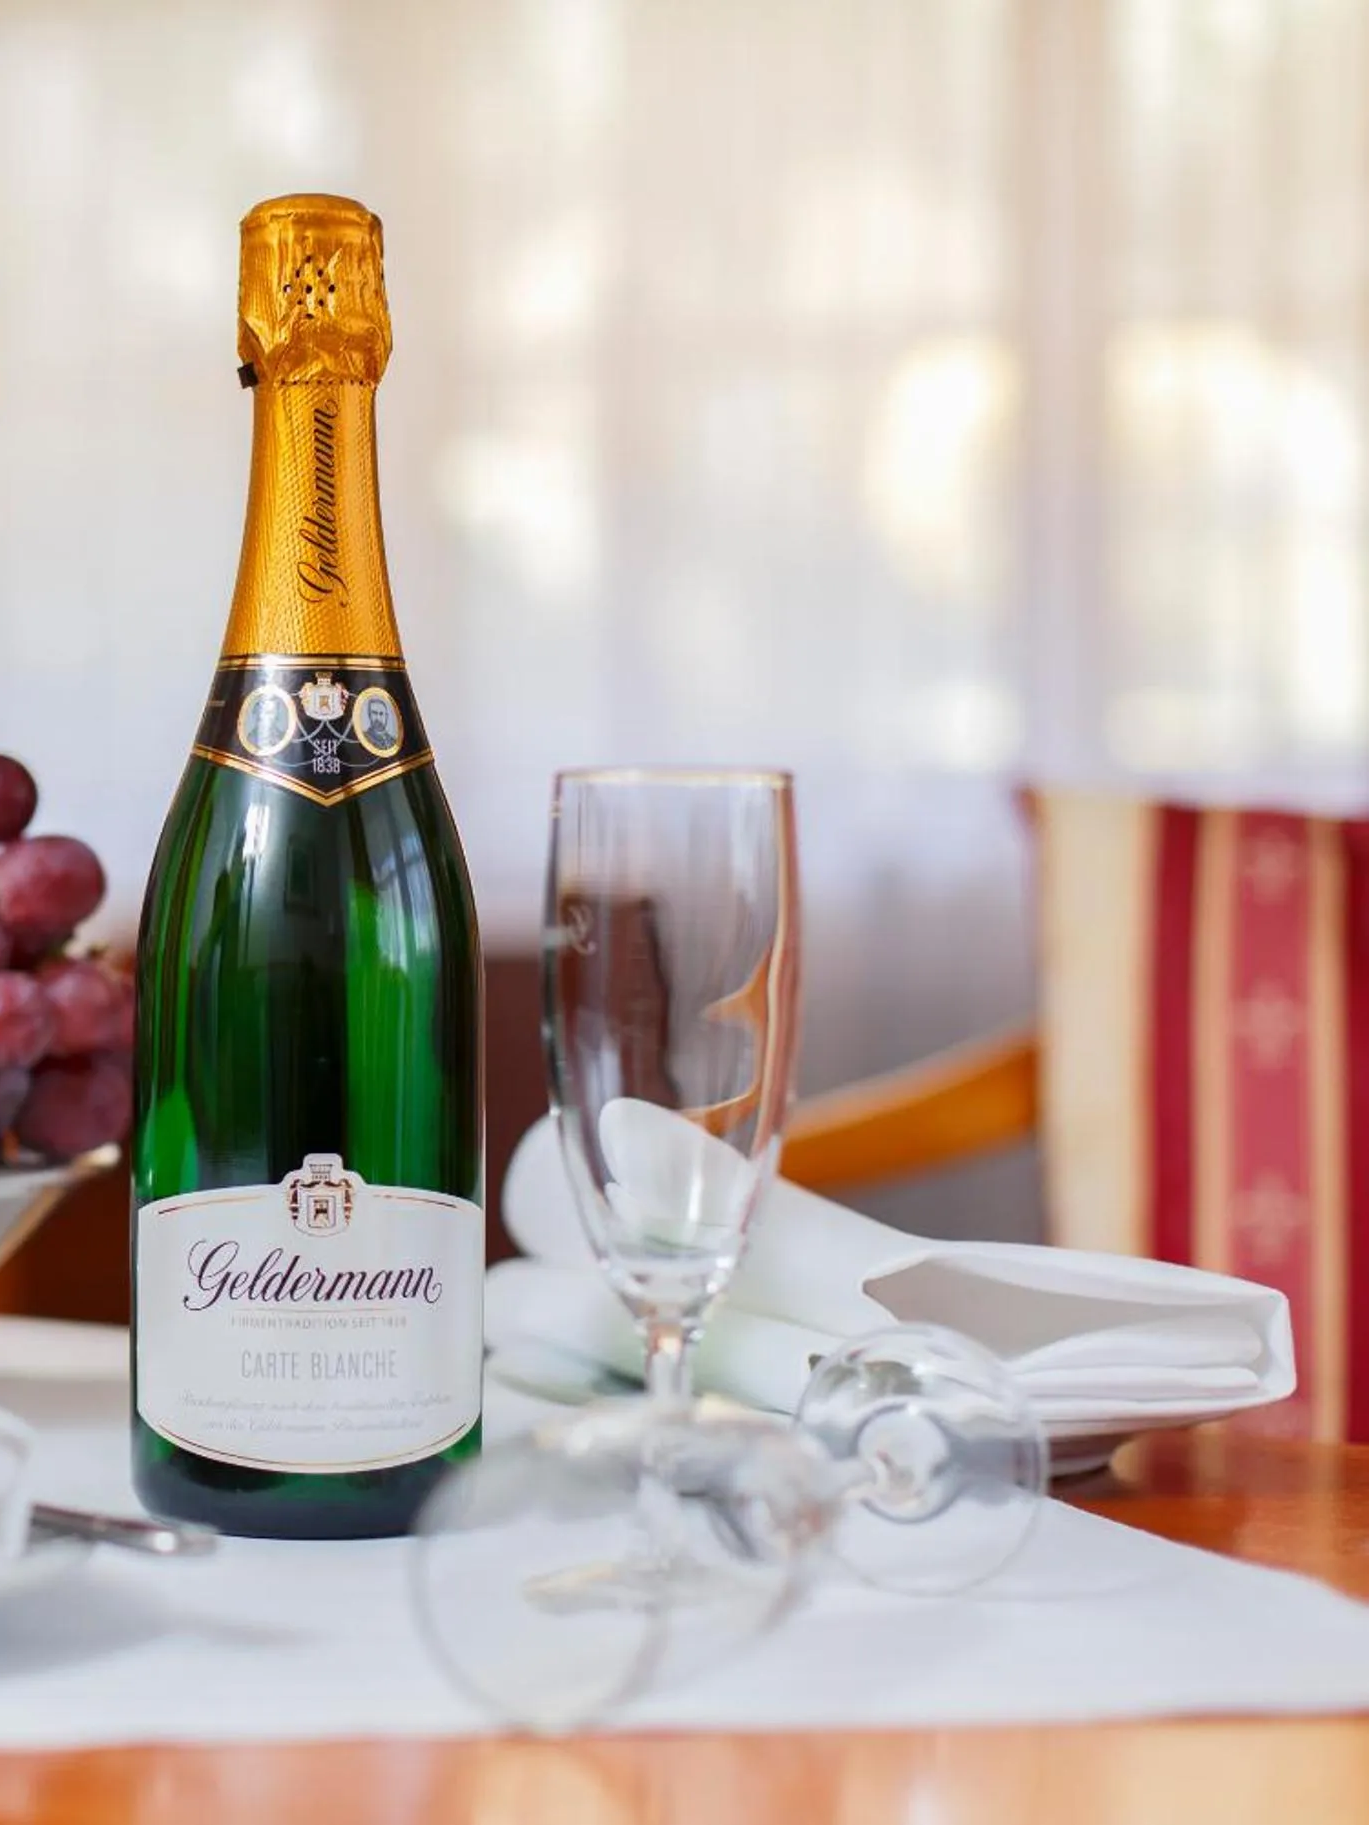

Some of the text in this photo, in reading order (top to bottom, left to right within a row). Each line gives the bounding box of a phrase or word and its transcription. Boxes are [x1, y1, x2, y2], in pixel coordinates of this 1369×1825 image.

[296, 399, 349, 608] Geldermann
[312, 738, 339, 756] SEIT
[313, 757, 340, 775] 1838
[183, 1240, 443, 1311] Geldermann
[240, 1349, 399, 1381] CARTE BLANCHE
